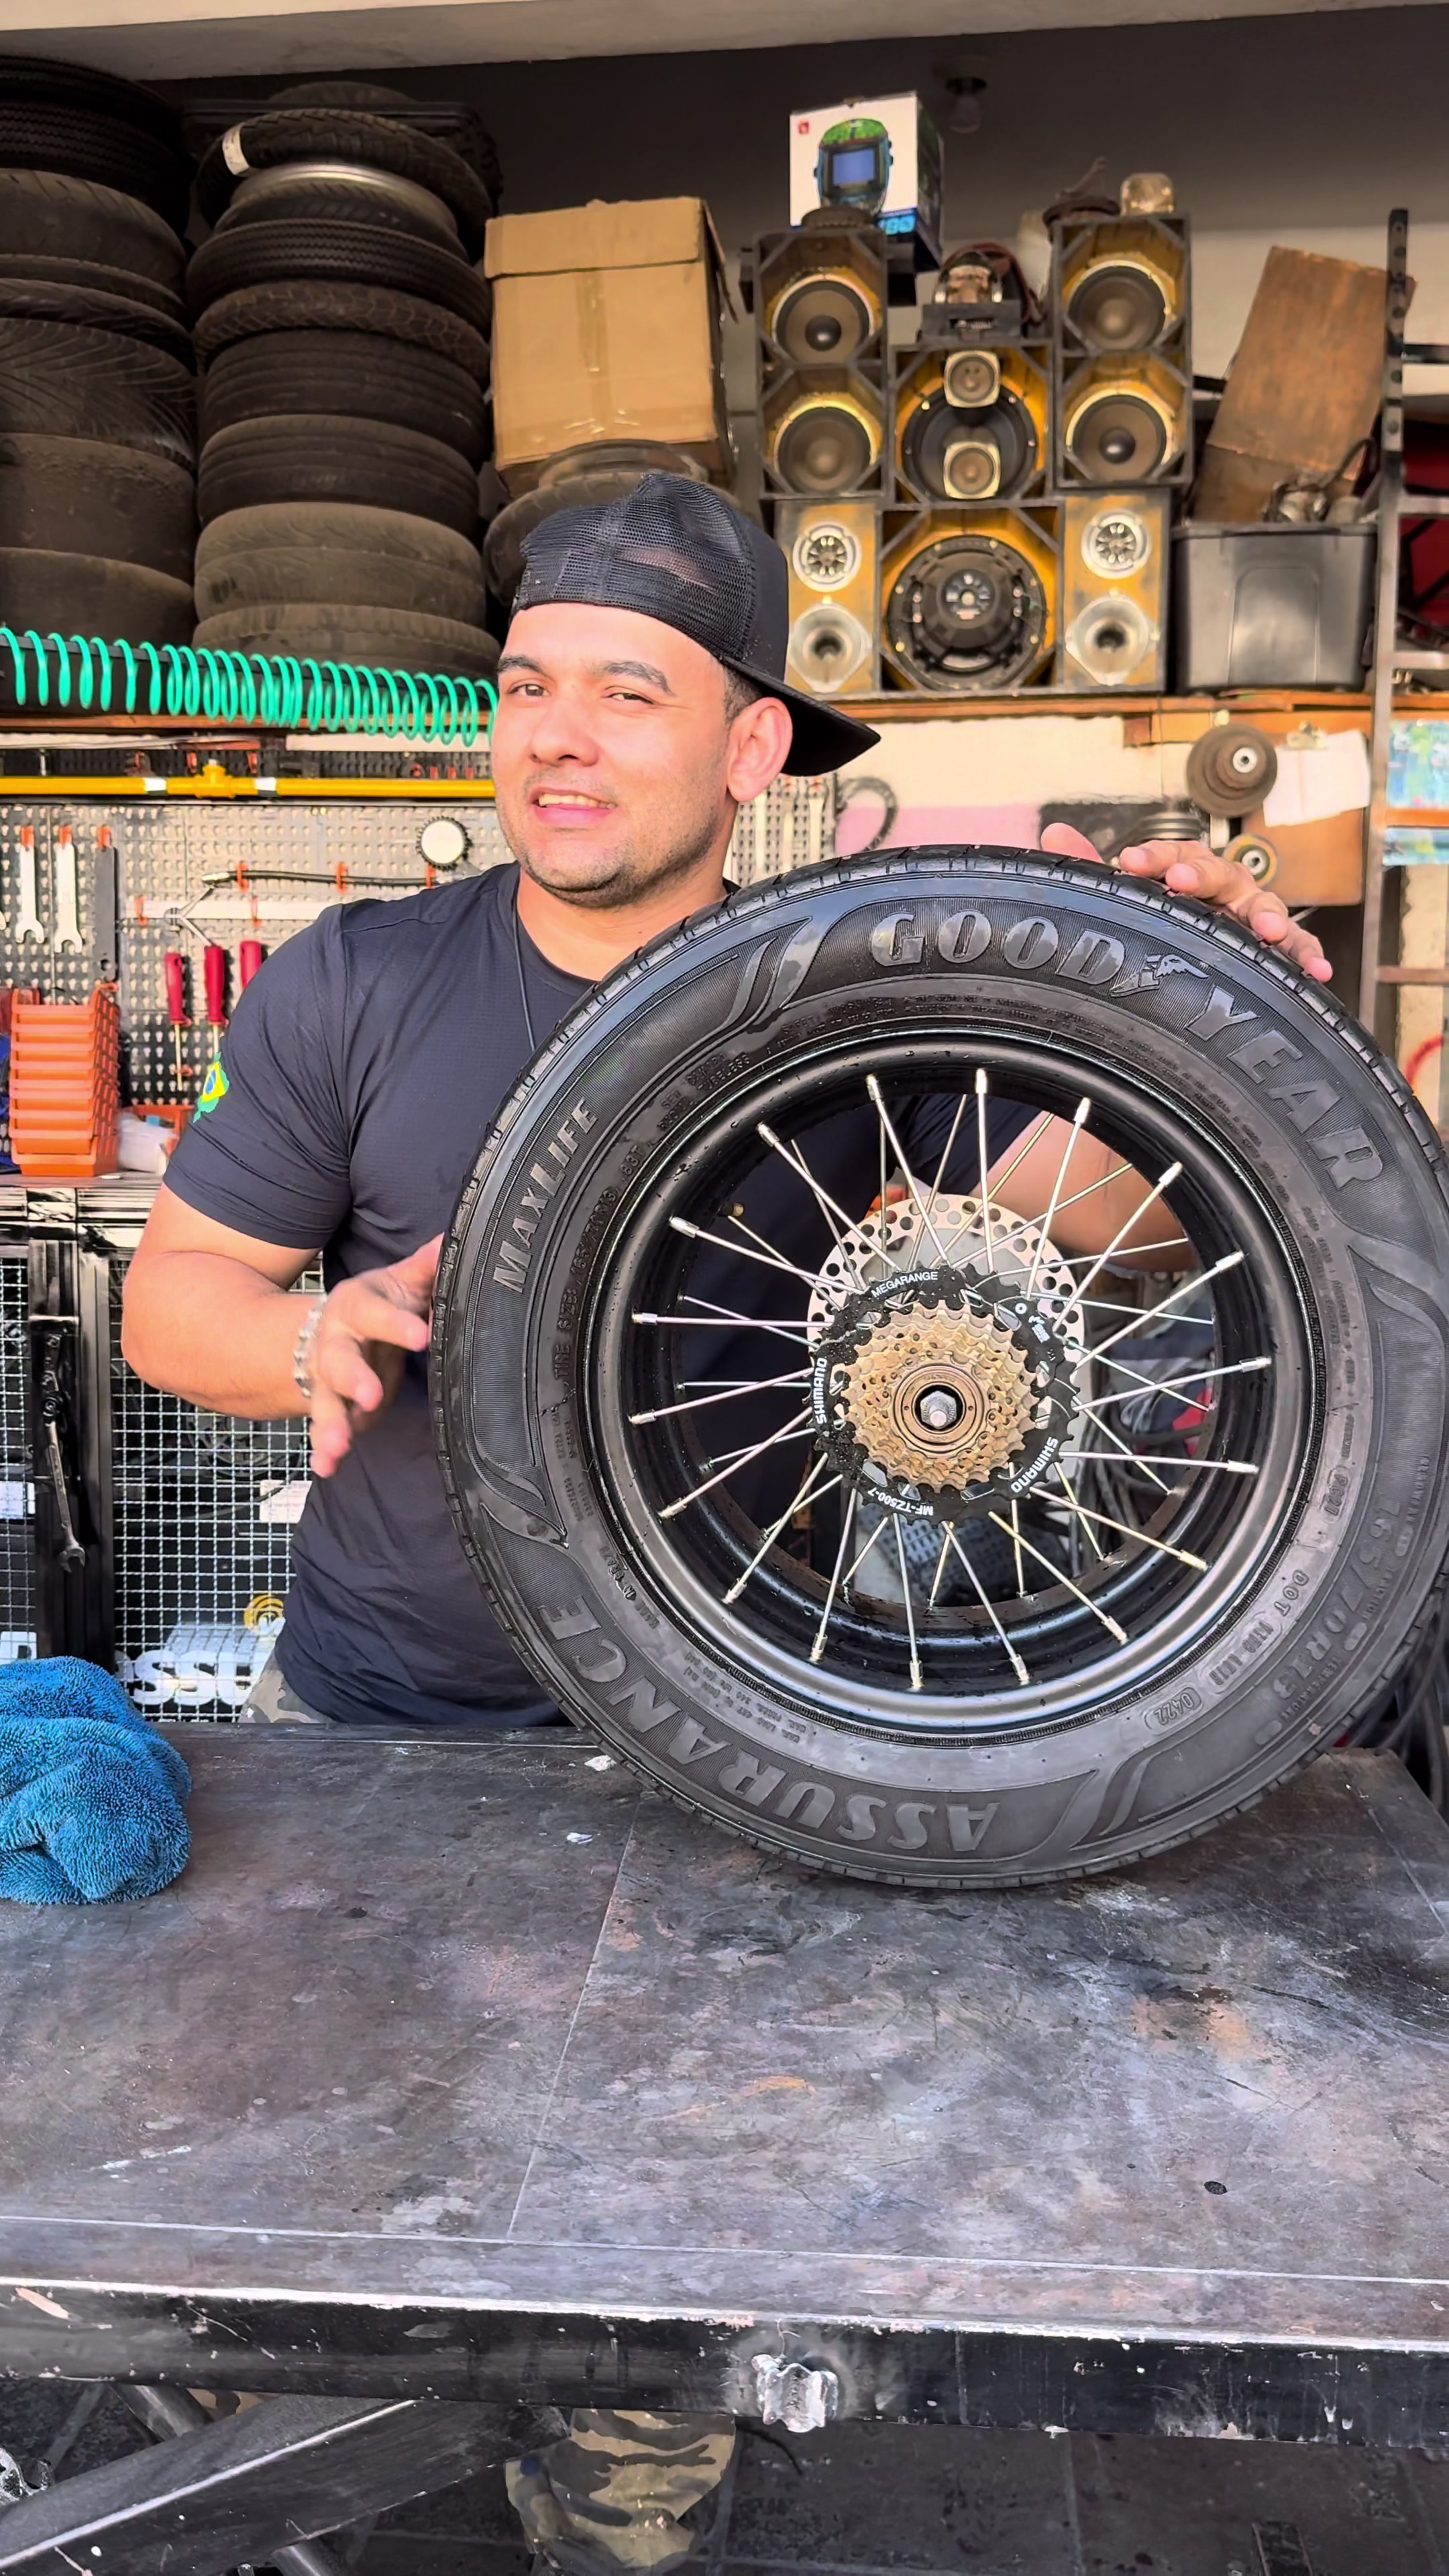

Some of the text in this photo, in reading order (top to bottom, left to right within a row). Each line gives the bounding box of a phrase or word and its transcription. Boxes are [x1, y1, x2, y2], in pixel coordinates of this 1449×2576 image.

[871, 1271, 938, 1298] MEGARANGE
[812, 1357, 828, 1424] SHIMANO
[1010, 1437, 1059, 1493] SHIMANO
[867, 1487, 933, 1515] MF-TZ500-7
[1273, 1569, 1309, 1617] DOT
[539, 1596, 1000, 1852] ASSURANCE
[1152, 1690, 1196, 1726] 0422
